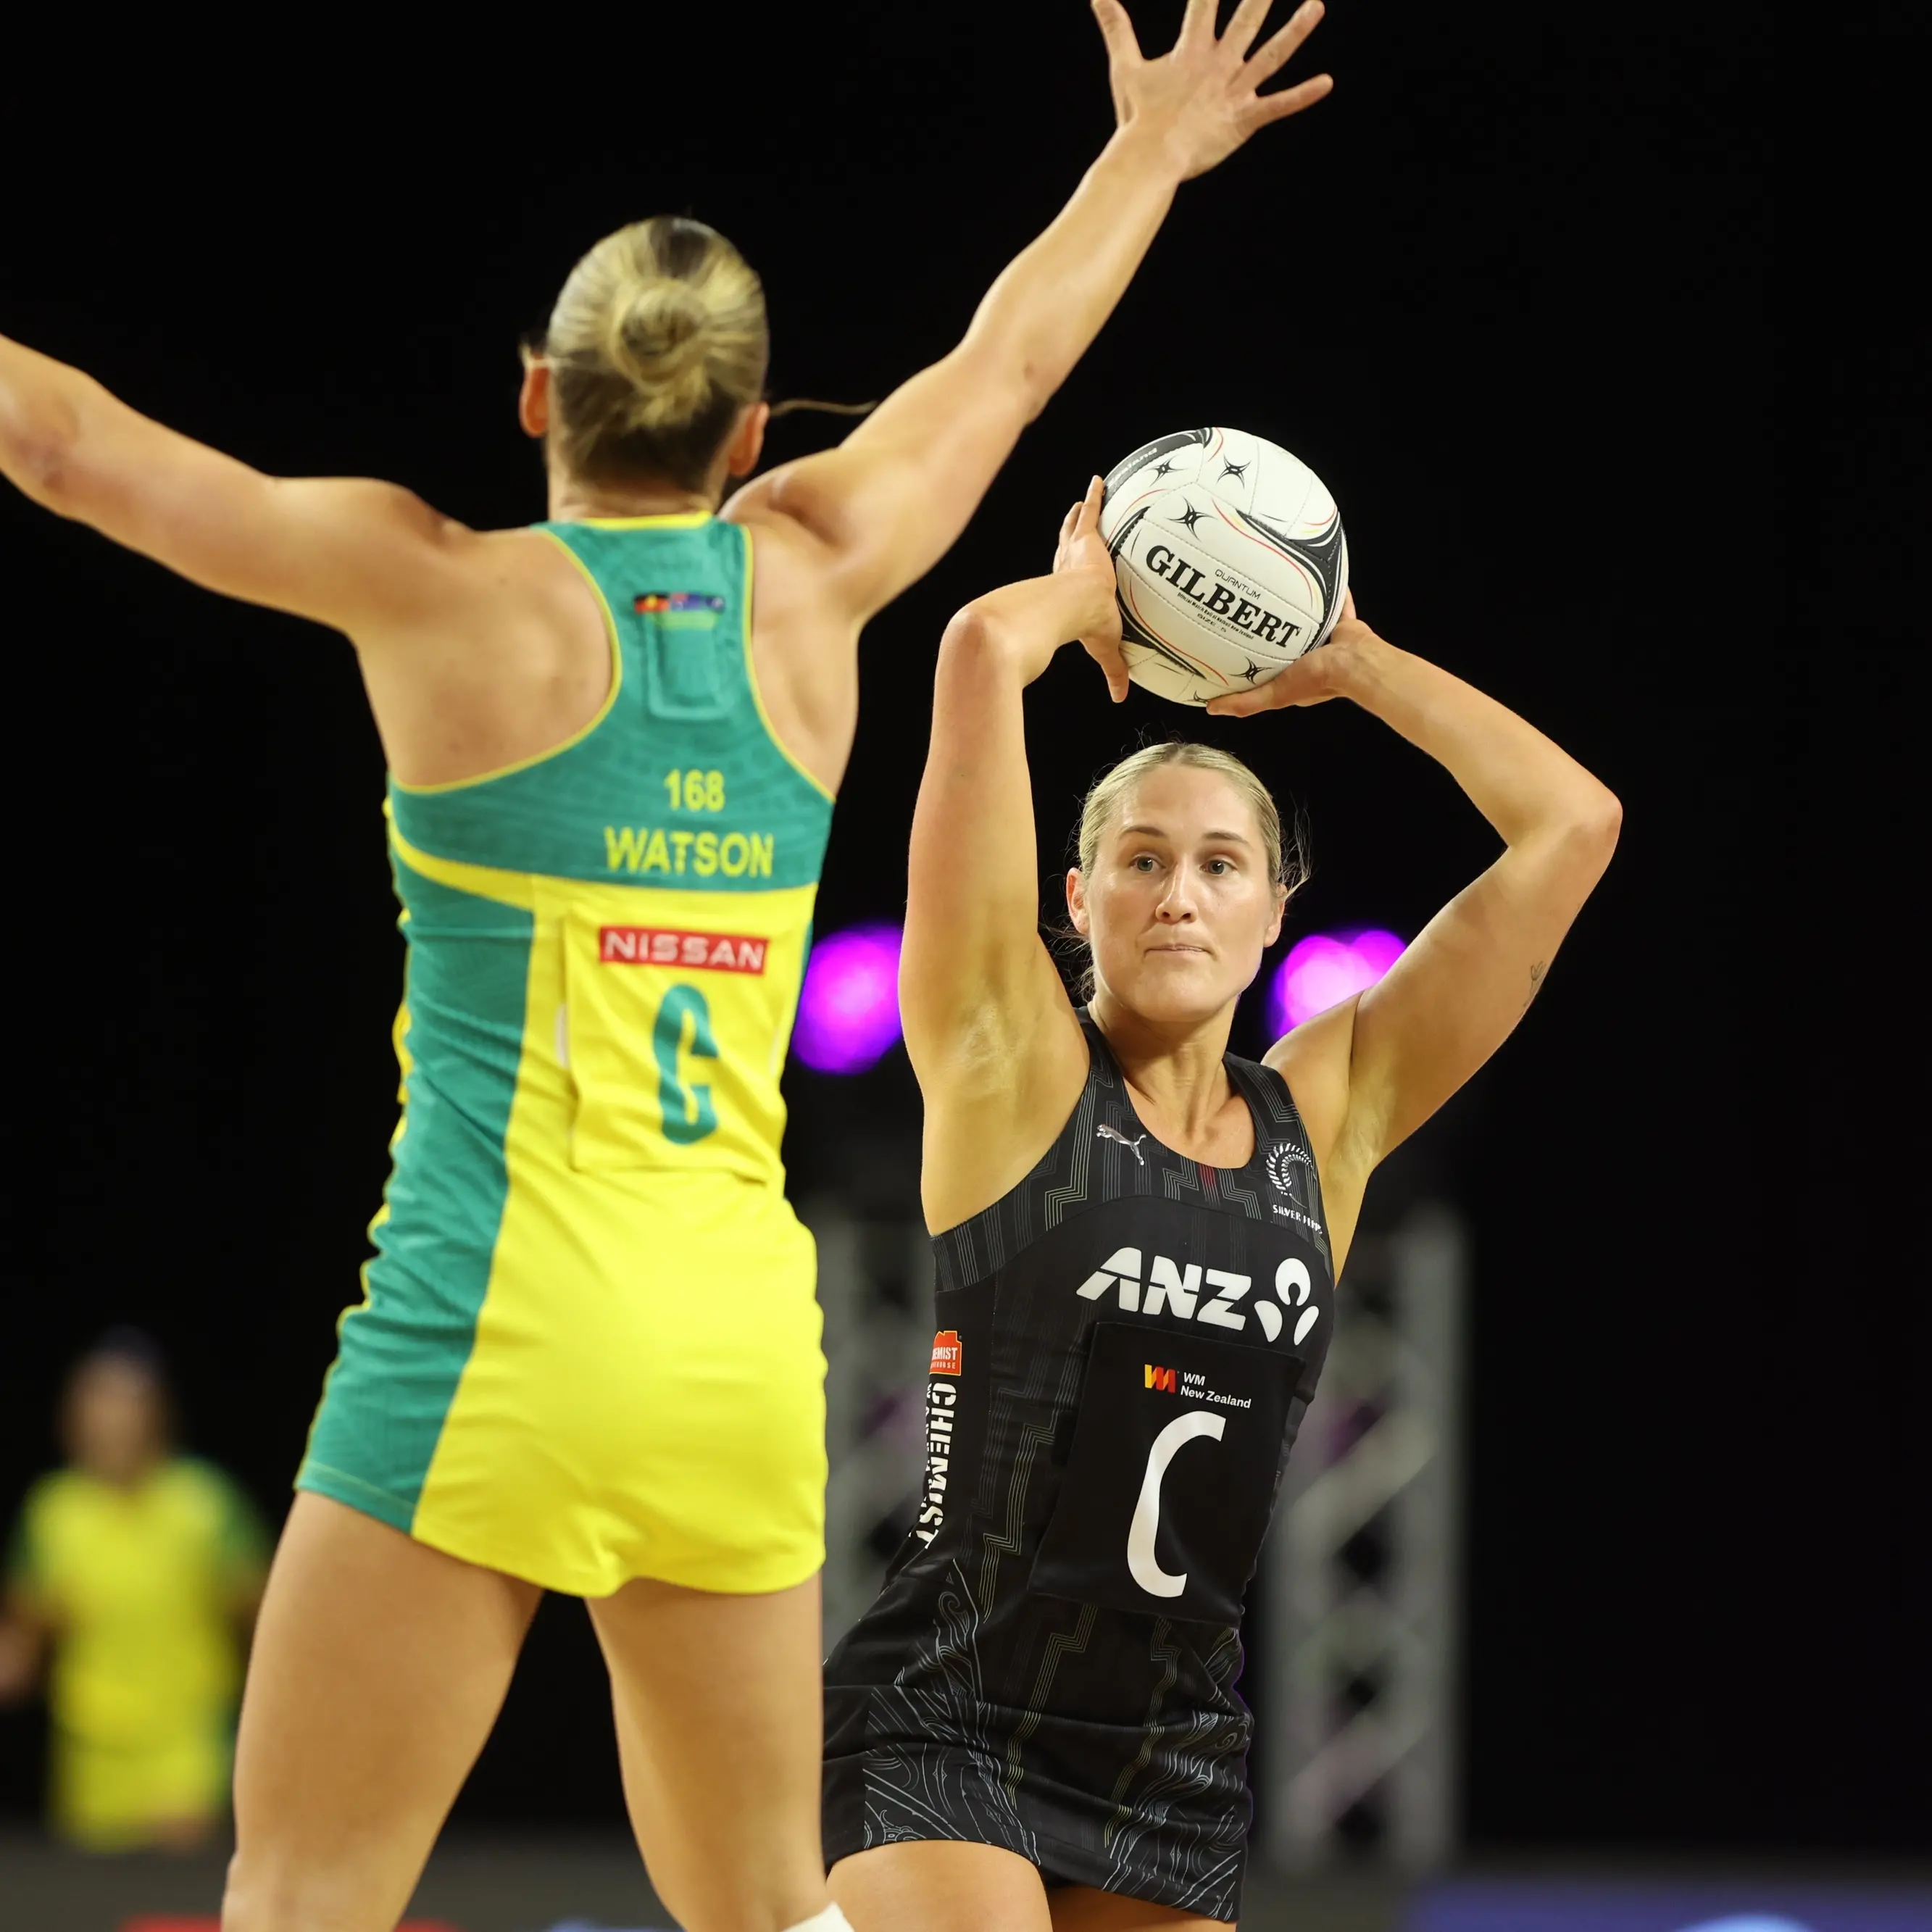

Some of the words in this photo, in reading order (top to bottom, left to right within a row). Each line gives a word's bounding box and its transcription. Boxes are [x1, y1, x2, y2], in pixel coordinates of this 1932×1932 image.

[1146, 545, 1302, 648] GILBERT
[1215, 569, 1261, 600] QUANTUM
[664, 769, 725, 812] 168
[604, 825, 774, 878] WATSON
[604, 930, 765, 970] NISSAN
[1273, 1204, 1301, 1222] SILVER
[1076, 1246, 1252, 1331] ANZ
[1181, 1385, 1205, 1399] New
[1206, 1391, 1252, 1409] Zealand
[1183, 1372, 1206, 1386] WM
[1127, 1410, 1226, 1598] C
